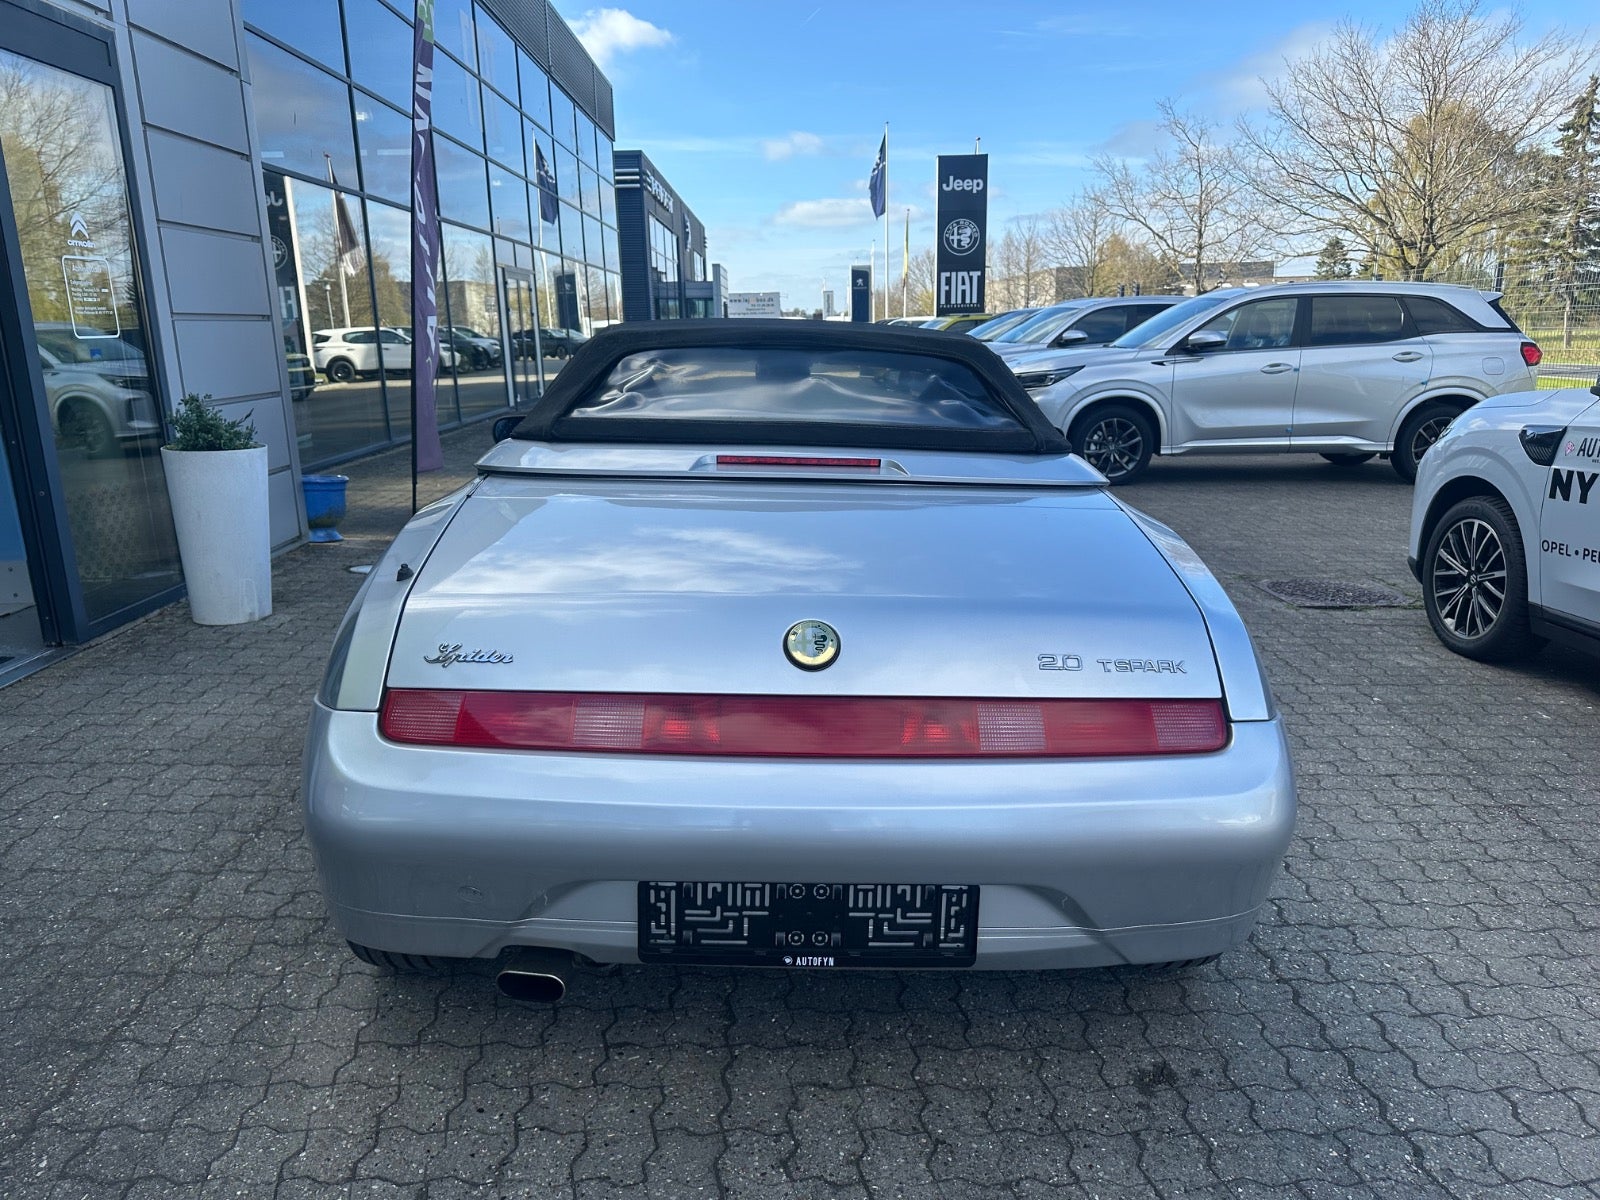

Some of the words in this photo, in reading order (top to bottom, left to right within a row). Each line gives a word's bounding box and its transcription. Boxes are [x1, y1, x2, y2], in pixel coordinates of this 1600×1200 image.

[942, 175, 984, 194] Jeep
[940, 270, 982, 305] FIAT
[1548, 467, 1600, 505] NY
[1541, 539, 1572, 557] OPEL
[1037, 653, 1083, 672] 2.0
[795, 956, 835, 967] AUTOFYN
